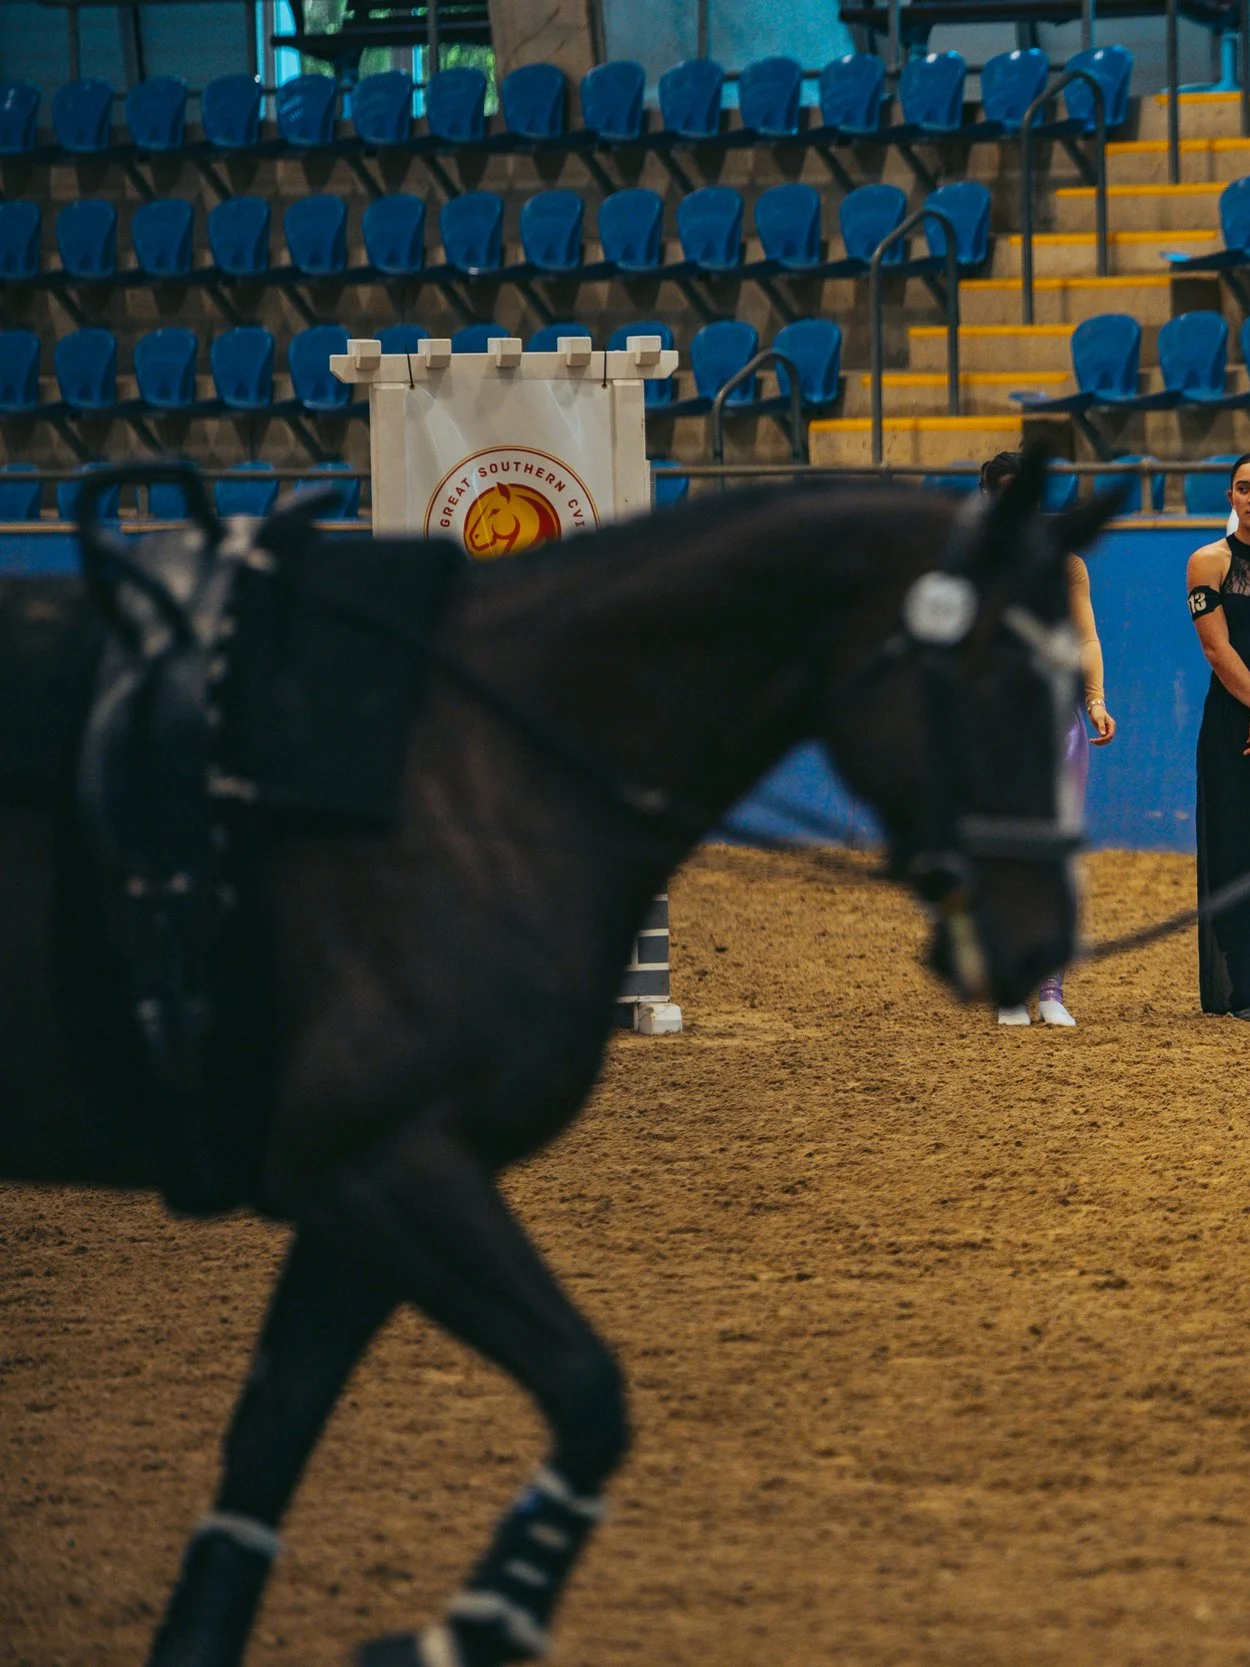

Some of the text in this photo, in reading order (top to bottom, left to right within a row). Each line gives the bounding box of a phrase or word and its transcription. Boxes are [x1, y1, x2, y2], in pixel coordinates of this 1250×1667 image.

[440, 461, 585, 528] GREAT SOUTHERN CVI
[1188, 592, 1207, 614] 13
